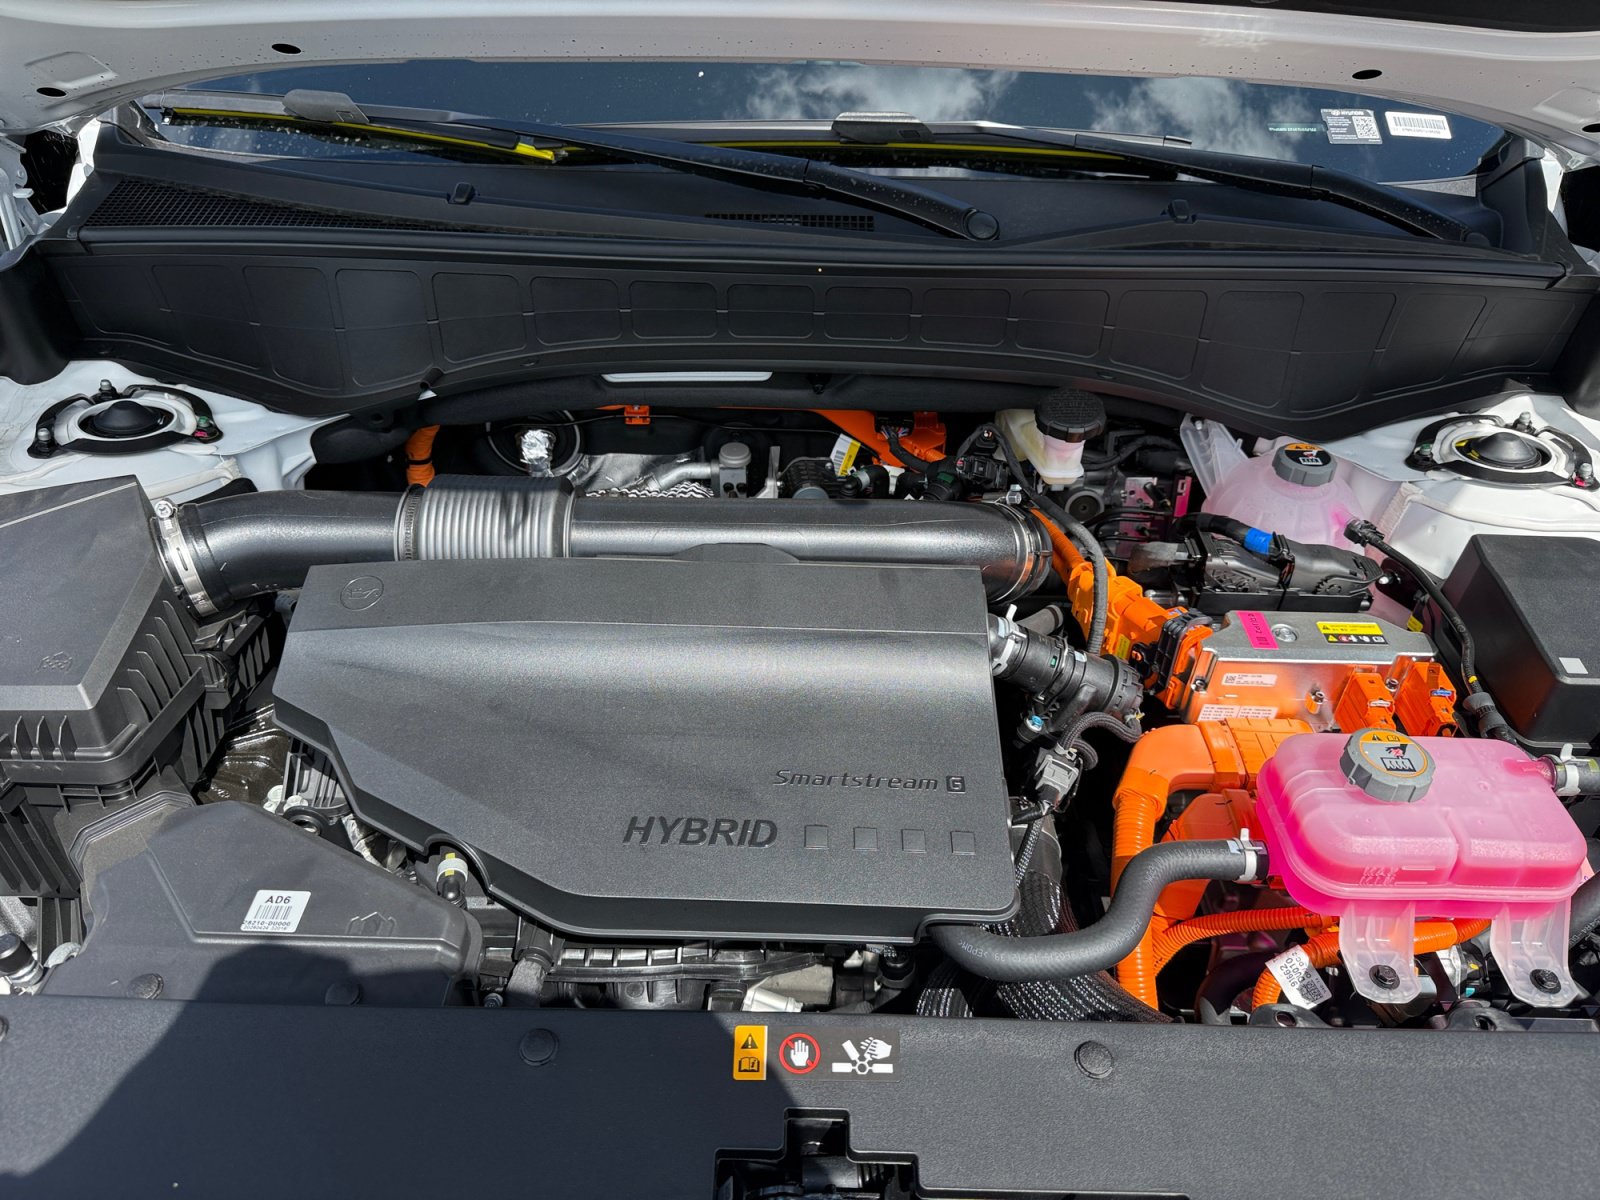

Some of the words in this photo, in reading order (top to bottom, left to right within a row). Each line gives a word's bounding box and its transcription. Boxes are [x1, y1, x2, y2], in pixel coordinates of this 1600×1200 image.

[773, 769, 938, 791] Smartstream
[622, 815, 778, 849] HYBRID
[265, 895, 292, 904] AD6
[1279, 963, 1298, 988] 91662
[1285, 957, 1305, 983] DU010
